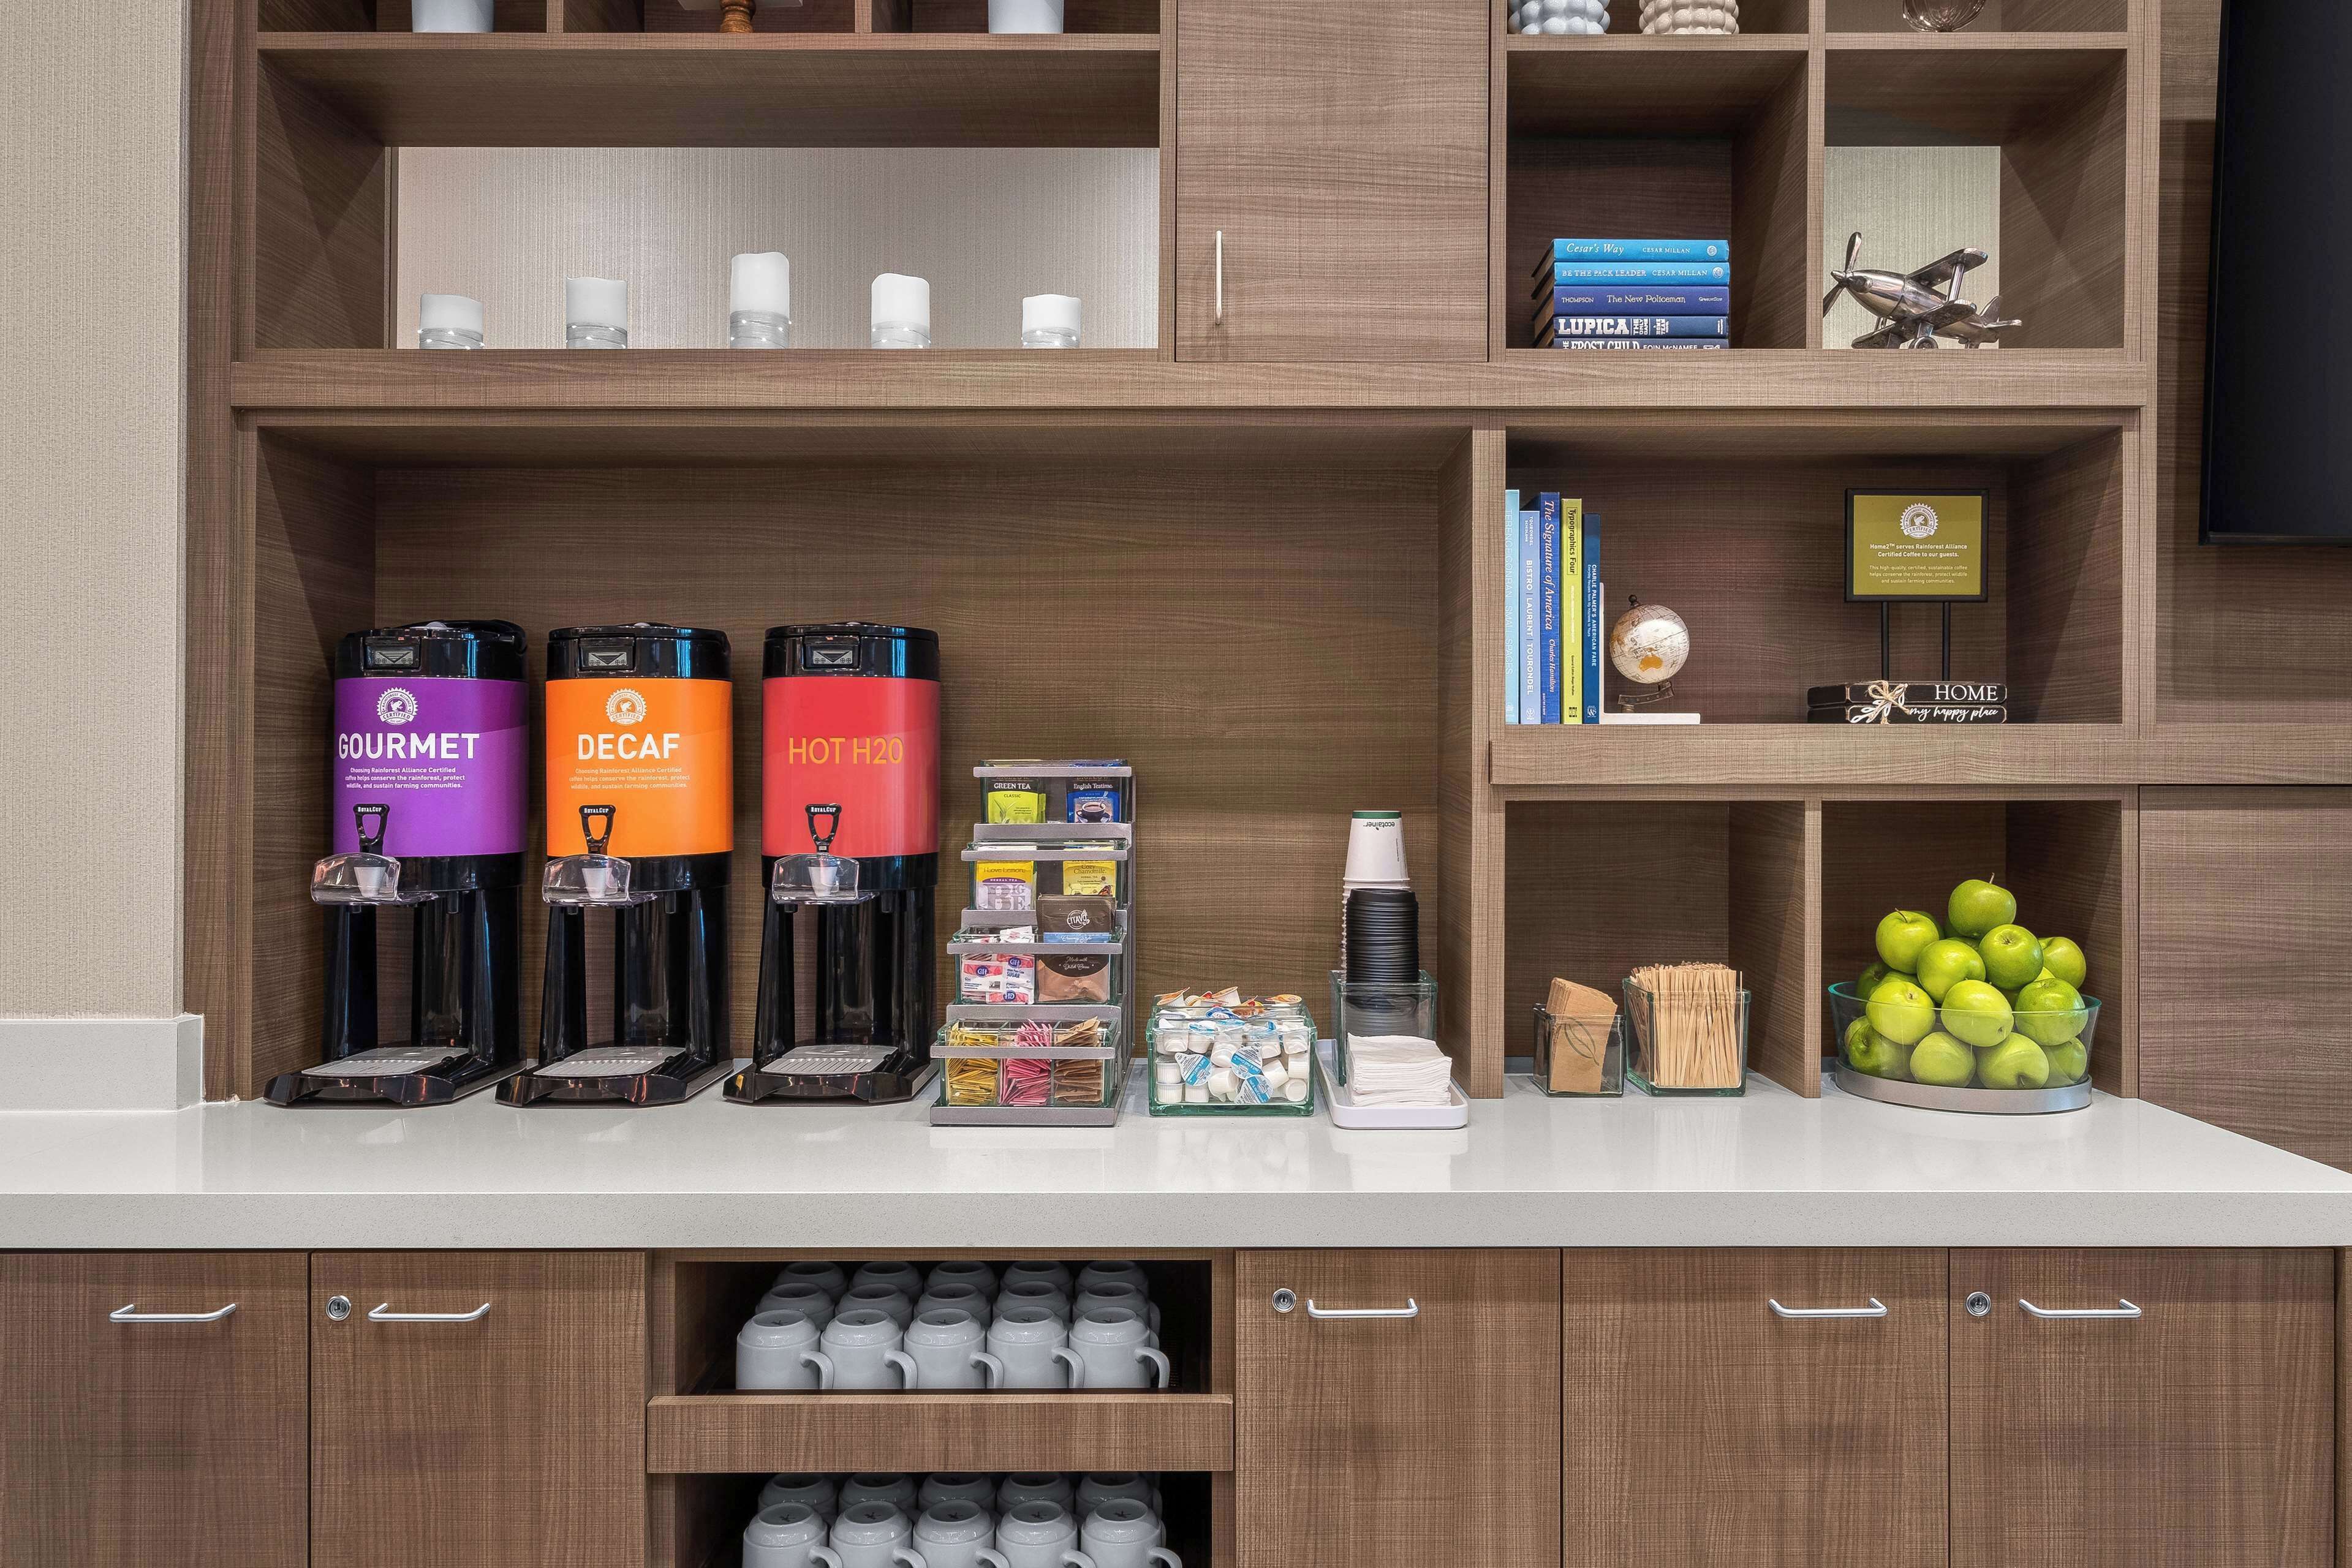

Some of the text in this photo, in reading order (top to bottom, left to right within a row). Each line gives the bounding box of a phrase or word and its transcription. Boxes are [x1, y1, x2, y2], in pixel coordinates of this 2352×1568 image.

[1567, 243, 1624, 256] Cesar's Way
[1606, 295, 1622, 303] The
[1624, 295, 1643, 303] New
[1646, 295, 1686, 303] Policeman
[1558, 318, 1630, 334] LUPICA
[1543, 500, 1556, 631] The Signature of America
[1935, 684, 1998, 701] HOME
[1909, 706, 1998, 722] my happy place
[339, 733, 480, 760] GOURMET
[578, 733, 680, 760] DECAF
[789, 737, 845, 764] HOT
